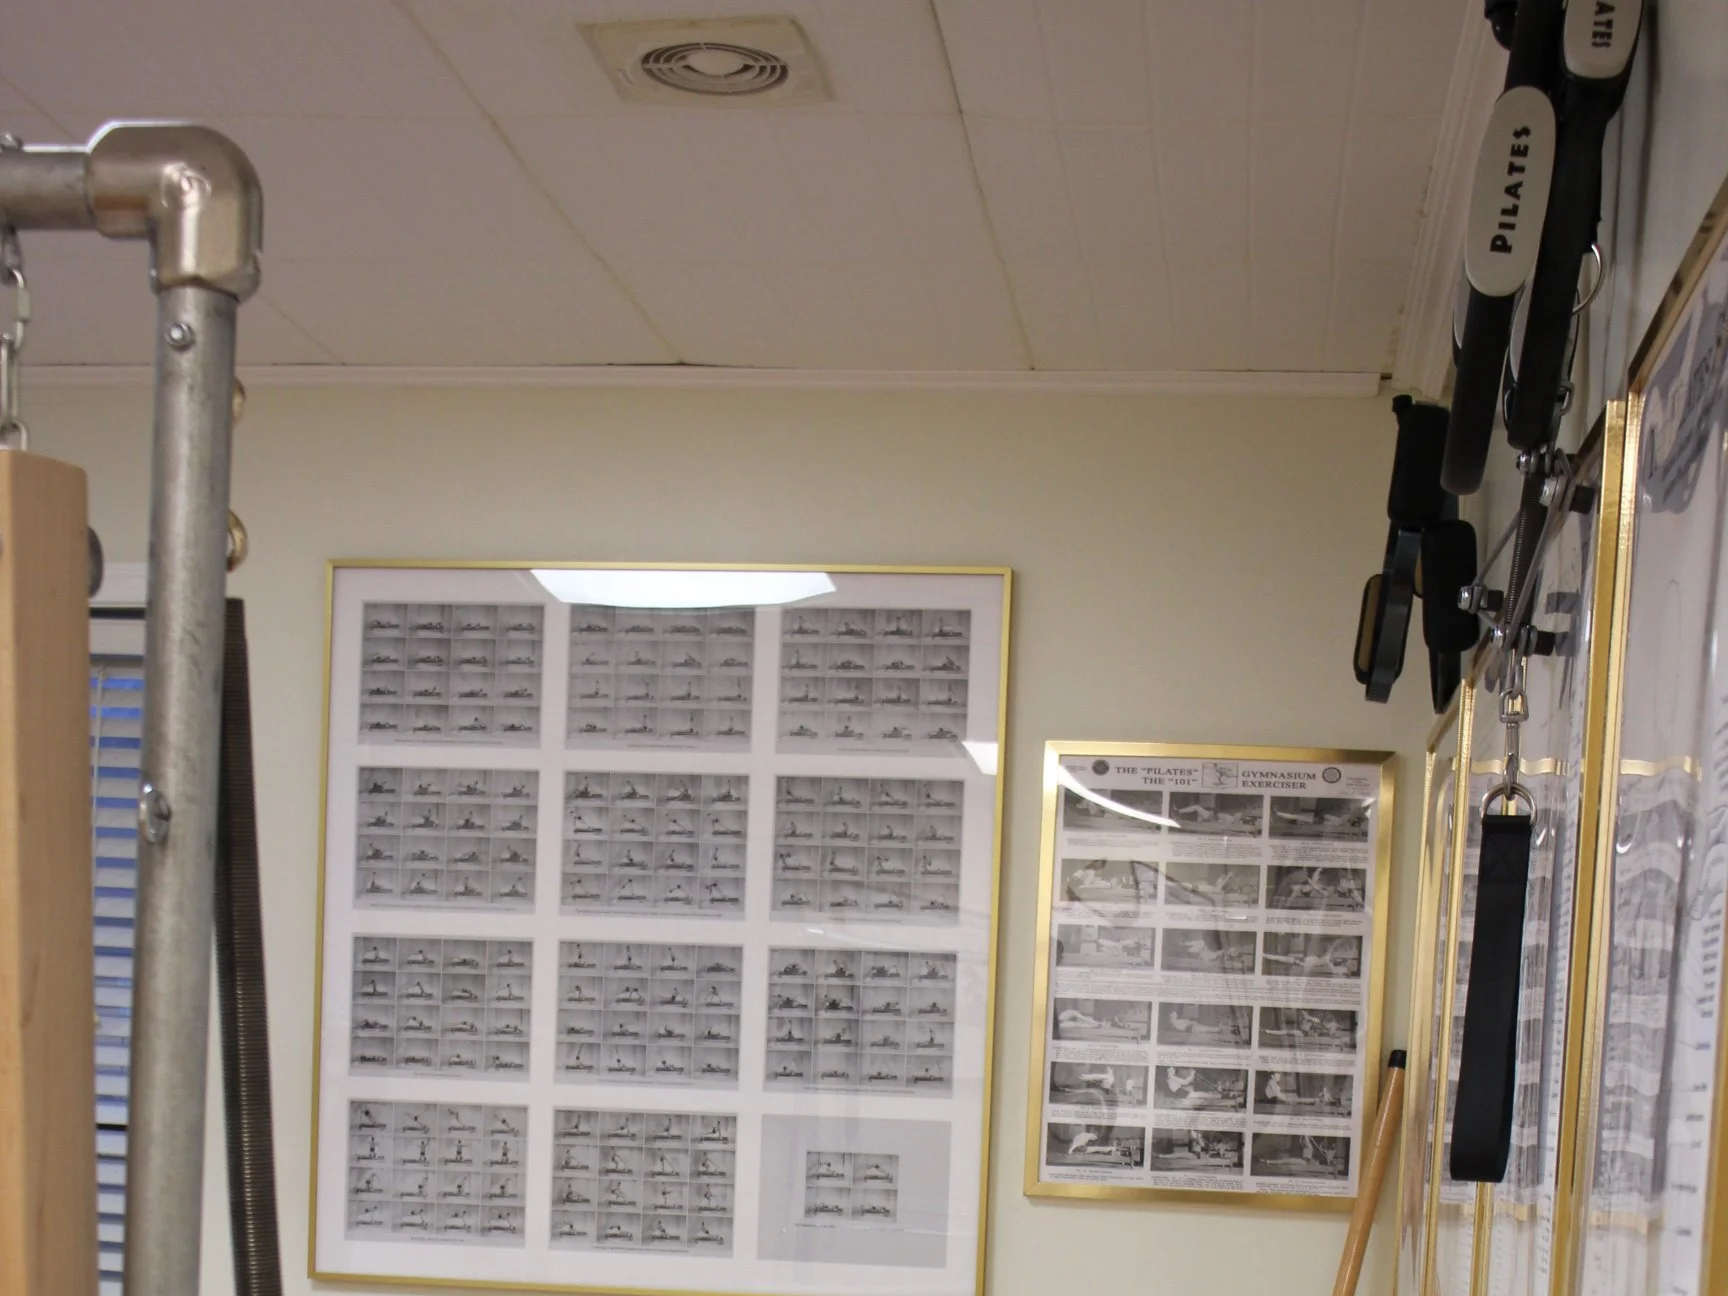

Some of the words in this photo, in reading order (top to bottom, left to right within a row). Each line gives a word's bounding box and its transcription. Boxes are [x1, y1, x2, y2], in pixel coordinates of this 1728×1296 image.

[1489, 125, 1532, 254] PILATES
[1115, 766, 1138, 775] THE
[1241, 770, 1317, 781] GYMNASIUM
[1143, 777, 1165, 786] THE
[1241, 780, 1307, 790] EXERCISER
